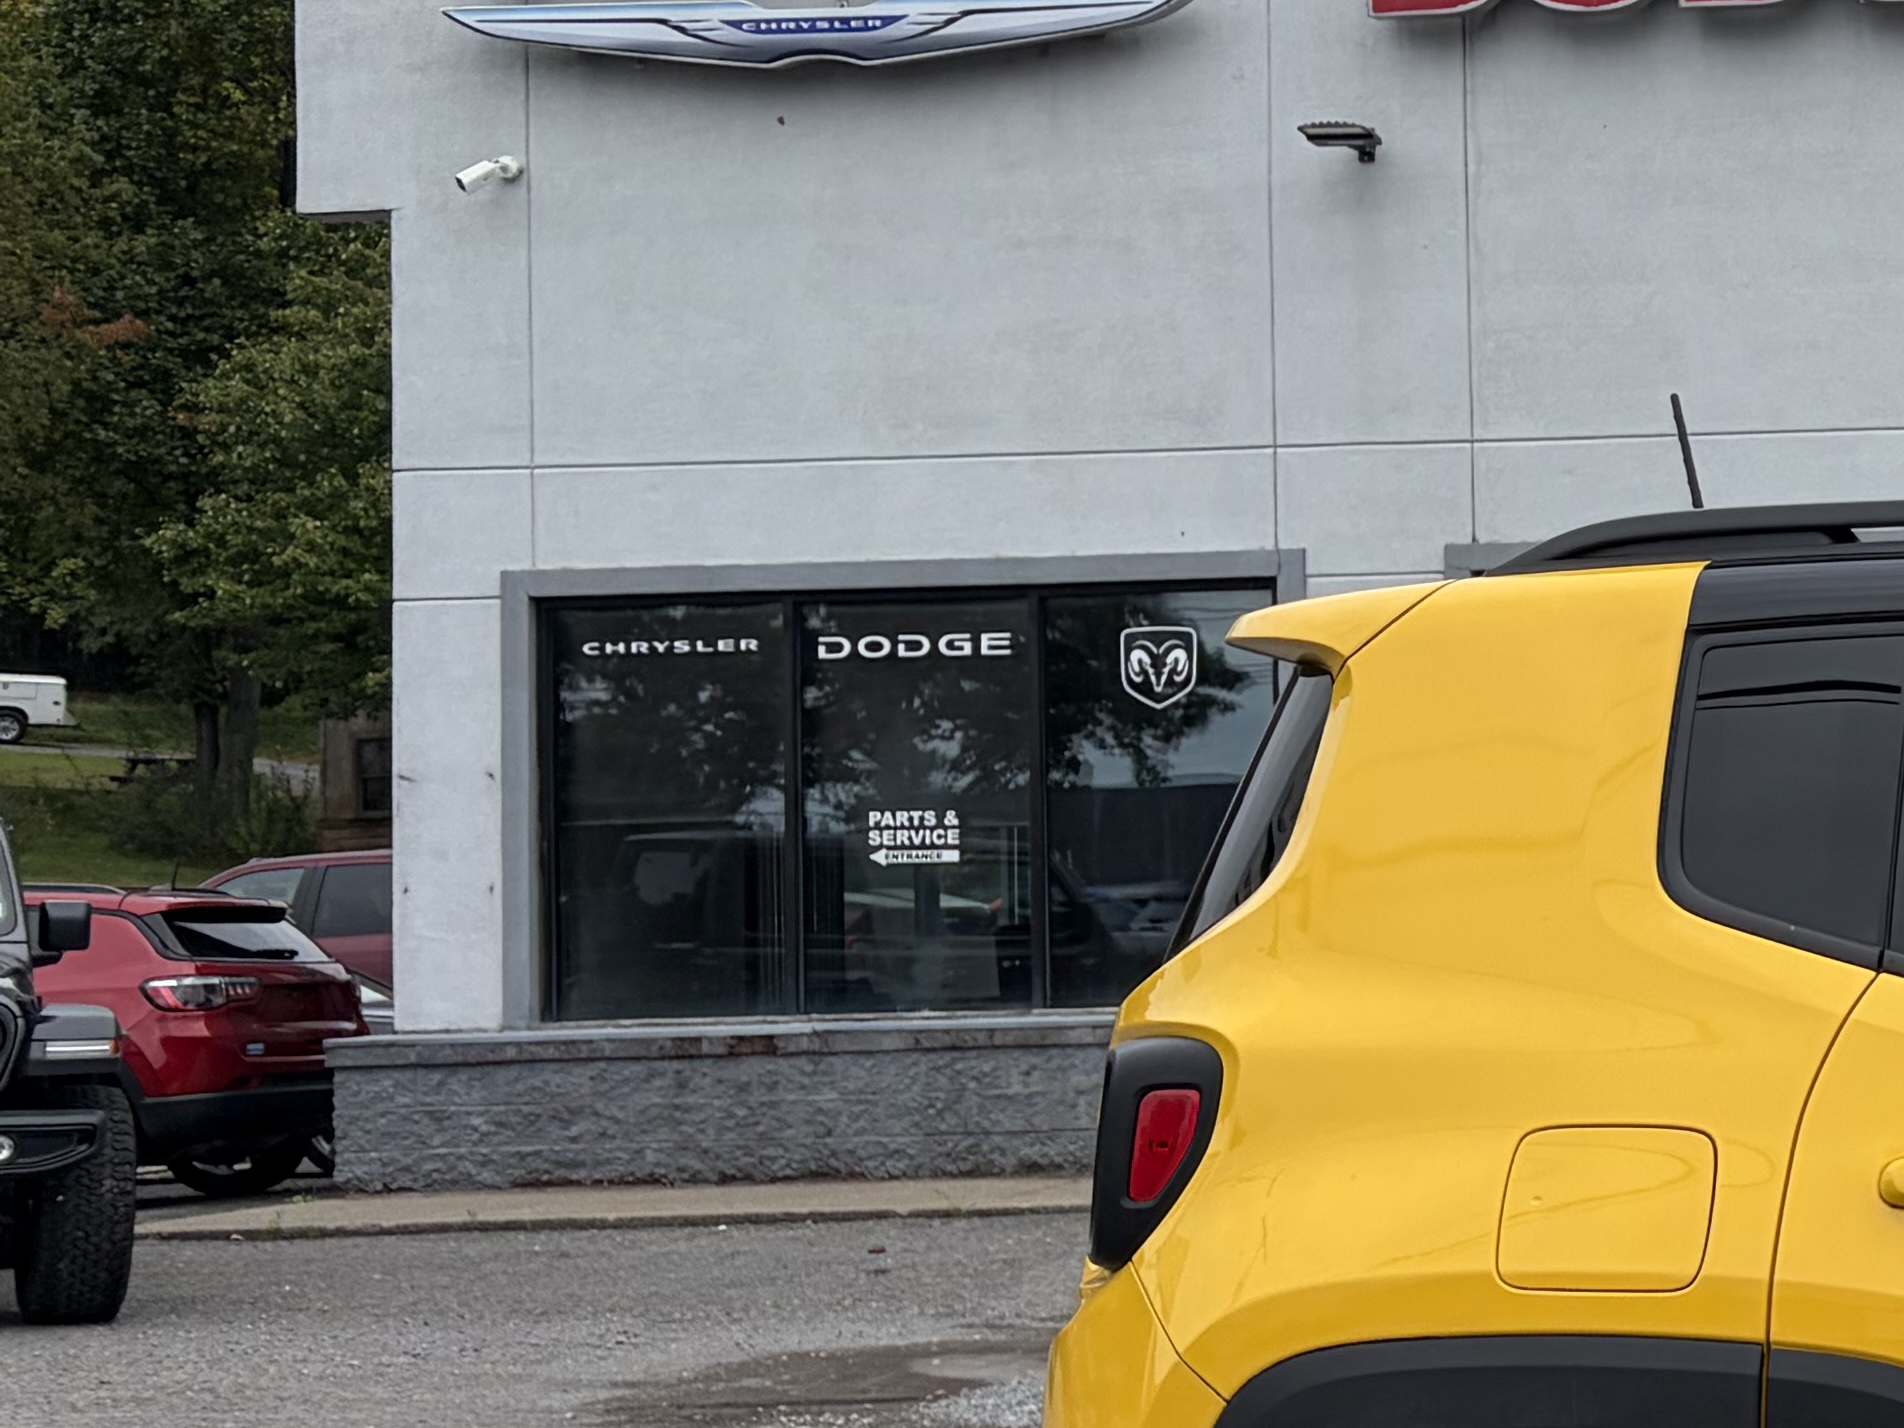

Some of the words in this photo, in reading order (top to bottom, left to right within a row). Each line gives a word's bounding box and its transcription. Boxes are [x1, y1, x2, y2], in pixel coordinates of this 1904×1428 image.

[742, 19, 882, 31] CHRYSLER
[582, 638, 758, 655] CHRYSLER
[817, 632, 1012, 660] DODGE
[868, 811, 937, 827] PARTS
[944, 810, 959, 826] &
[868, 829, 960, 846] SERVICE
[884, 852, 942, 861] ENTRANCE
